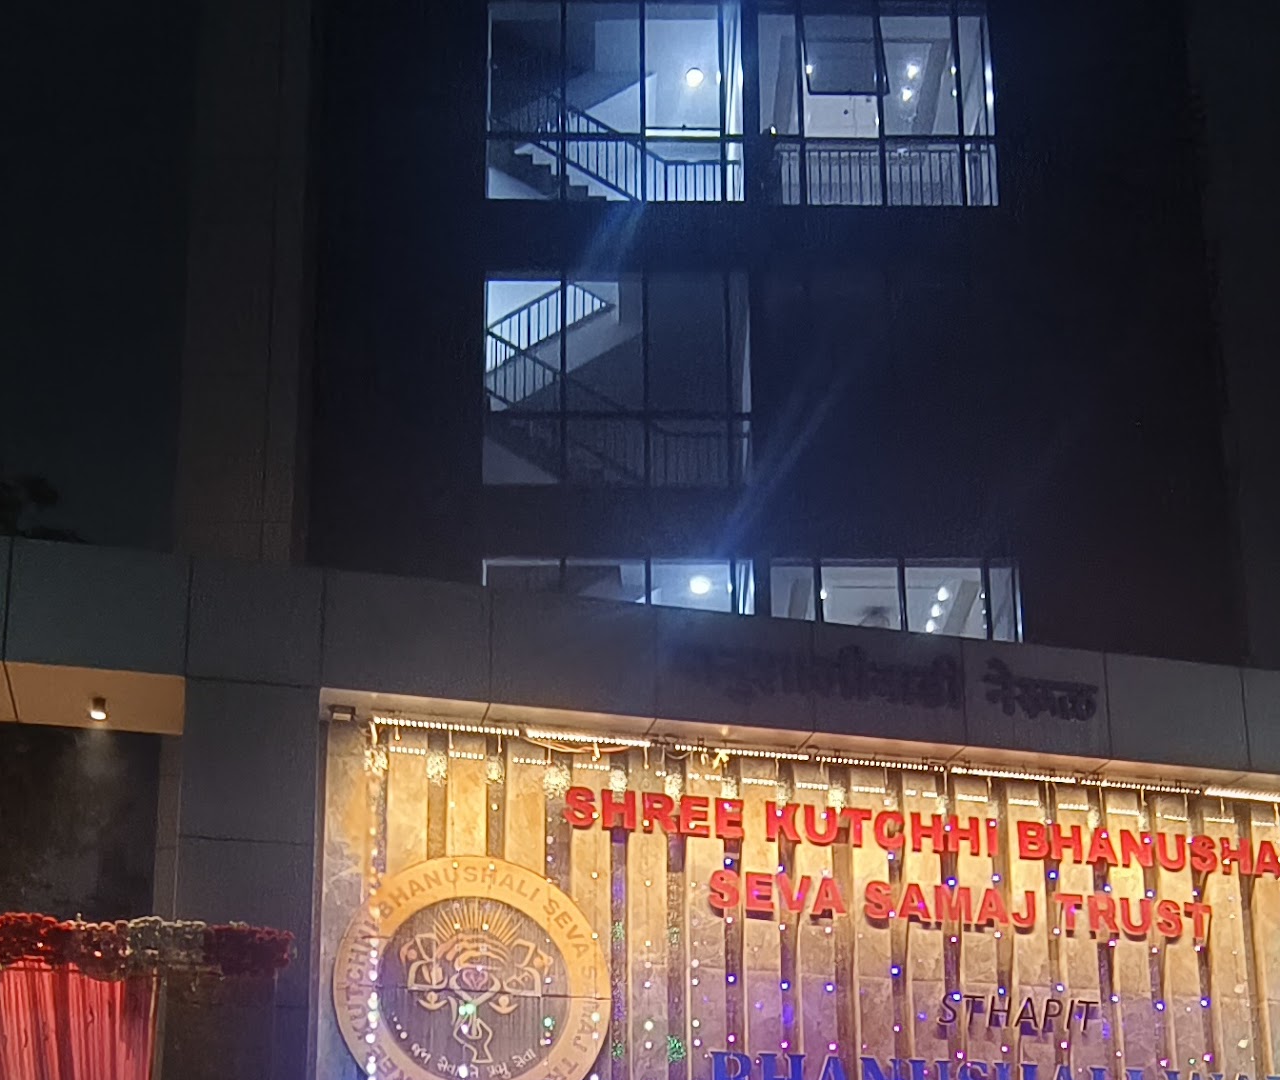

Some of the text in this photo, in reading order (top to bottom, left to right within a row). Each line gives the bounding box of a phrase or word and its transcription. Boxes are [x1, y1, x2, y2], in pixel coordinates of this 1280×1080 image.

[563, 786, 744, 839] SHREE
[765, 800, 998, 857] KUTCHHI
[379, 865, 541, 921] BHANUSHALI
[542, 900, 591, 959] SEVA
[708, 869, 1211, 938] SEVA SAMAJ TRUST
[938, 994, 1098, 1032] STHAPIT
